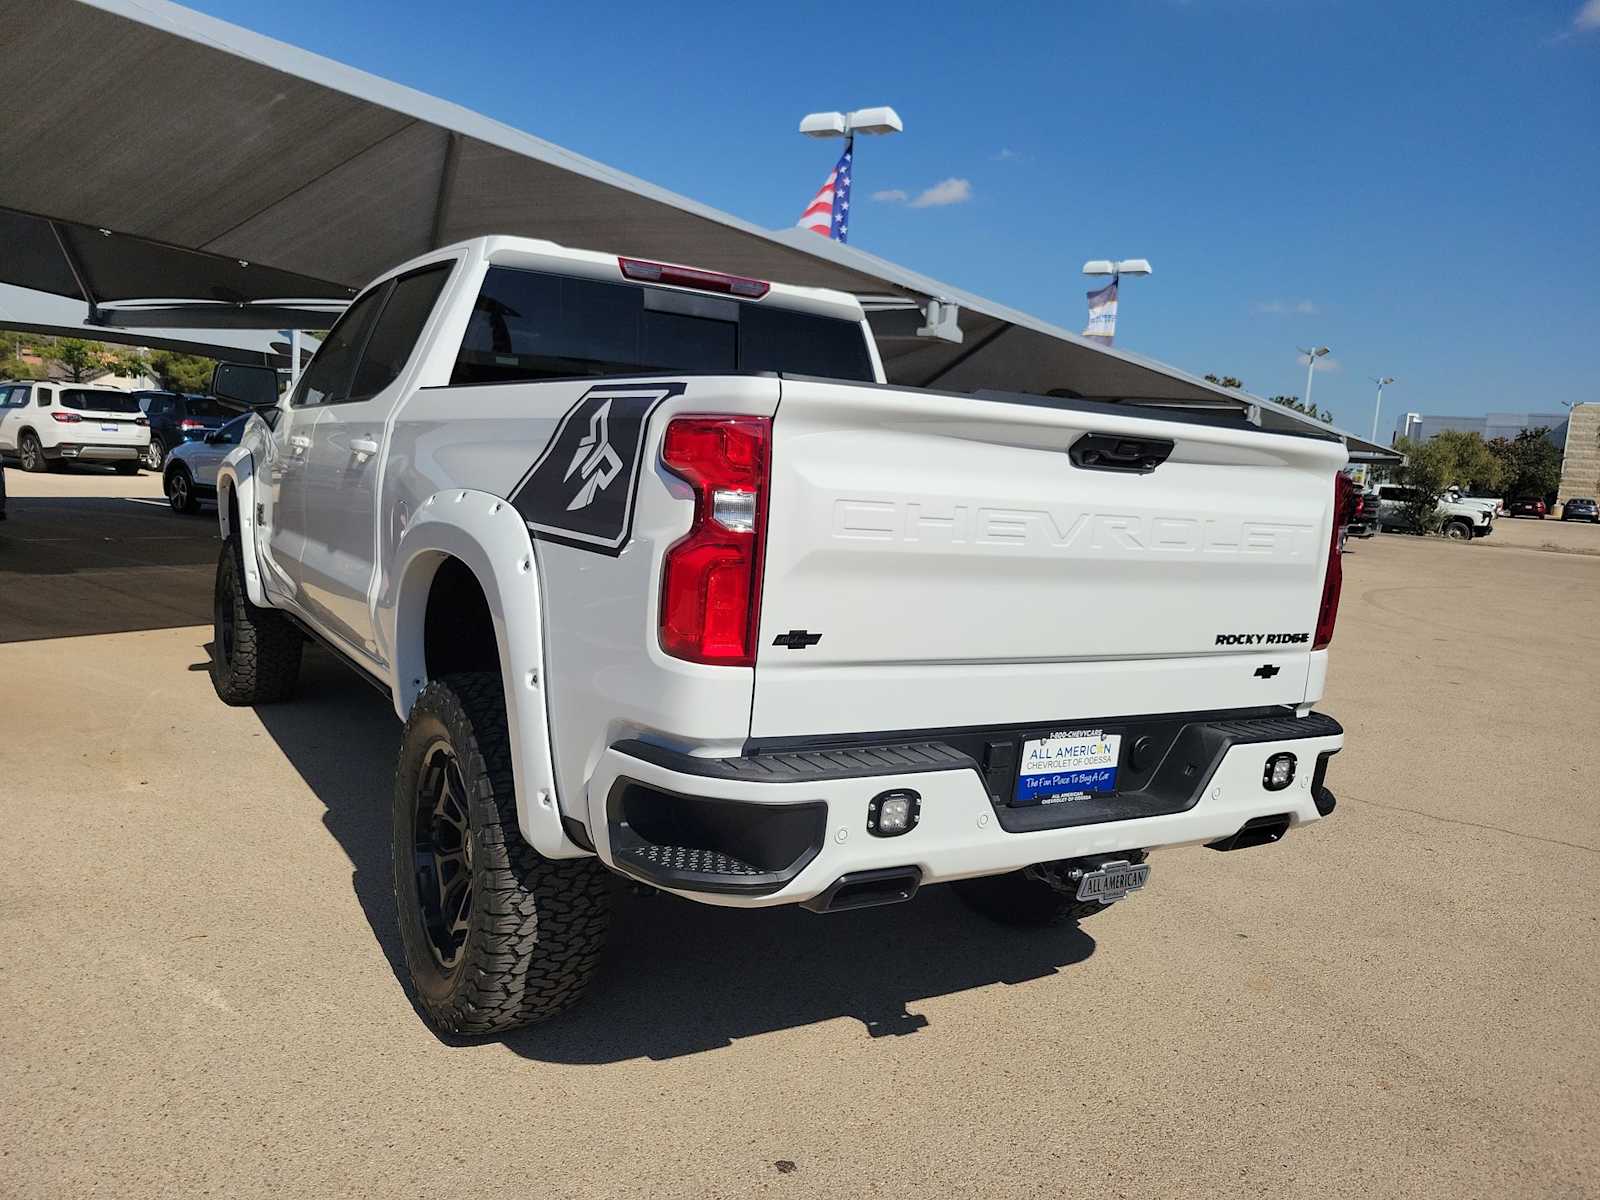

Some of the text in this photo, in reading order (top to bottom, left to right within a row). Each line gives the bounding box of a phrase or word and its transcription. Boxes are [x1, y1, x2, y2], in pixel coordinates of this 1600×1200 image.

[831, 498, 1315, 556] CHEVROLET
[1215, 632, 1310, 645] ROCKY RIDGE
[1030, 748, 1052, 759] ALL
[1026, 755, 1112, 770] CHEVROLET OF ODESSA
[1026, 777, 1039, 788] The
[1070, 774, 1079, 784] To
[1079, 773, 1092, 785] Buy
[1092, 772, 1098, 782] A
[1087, 870, 1147, 894] ALL AMERICAN
